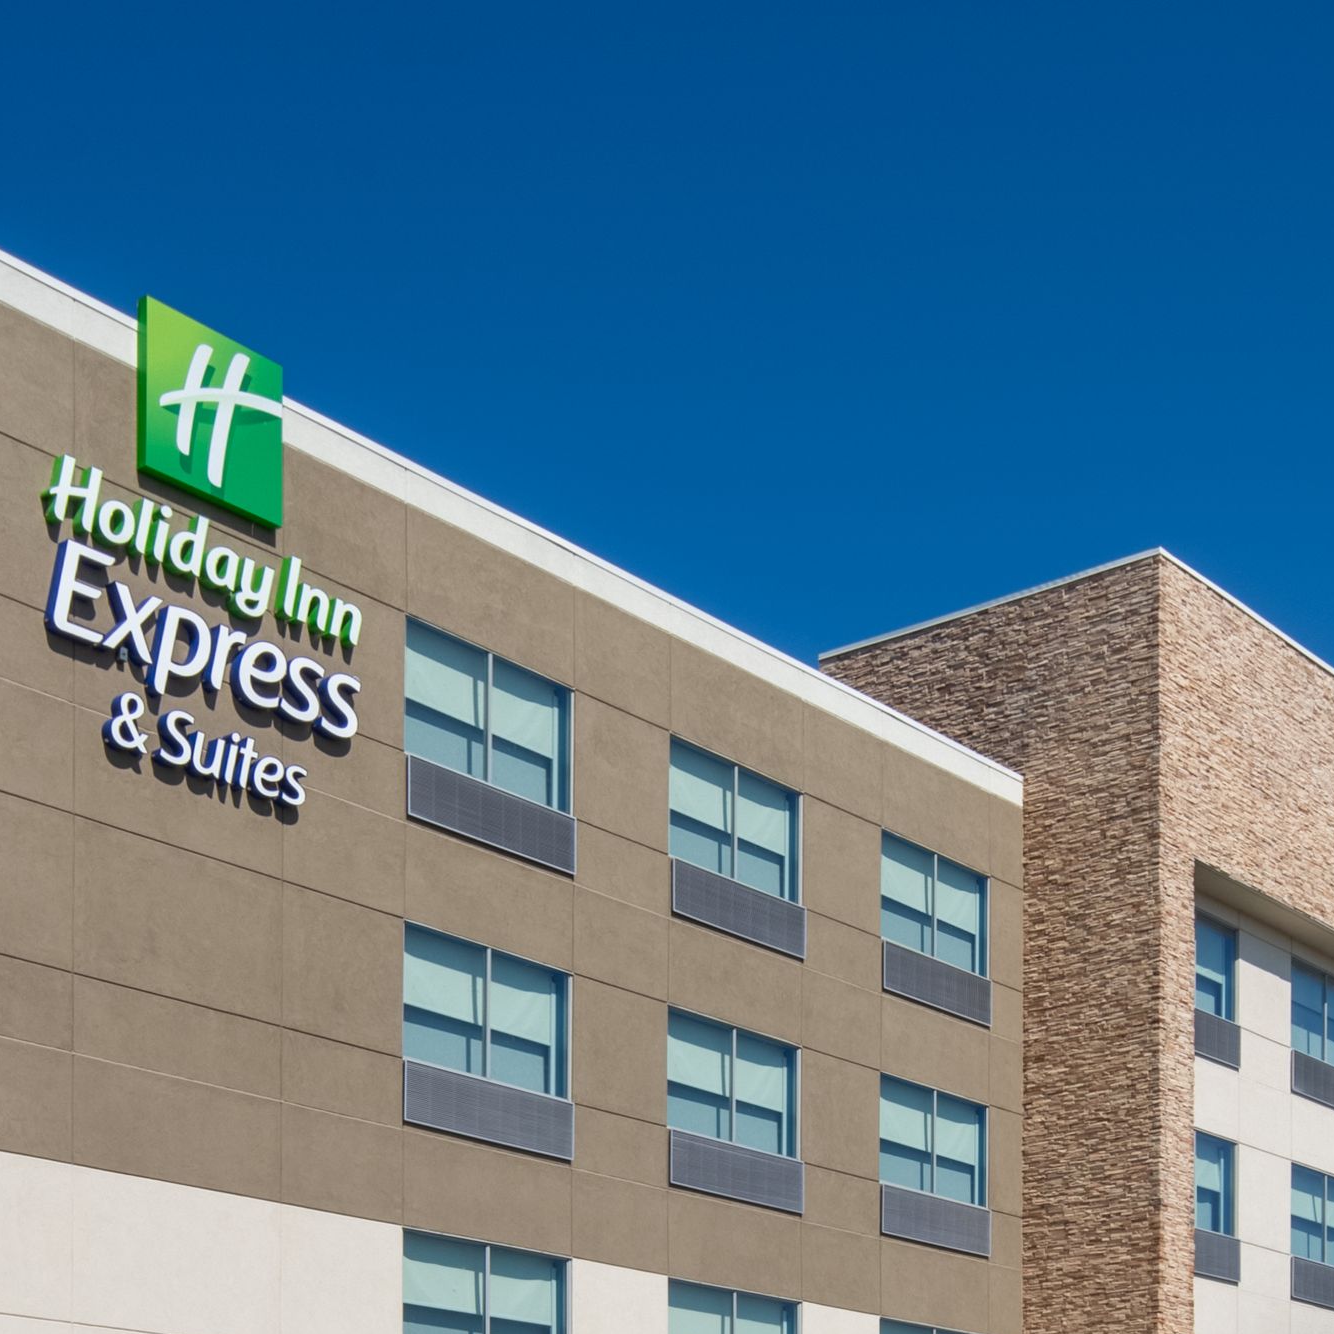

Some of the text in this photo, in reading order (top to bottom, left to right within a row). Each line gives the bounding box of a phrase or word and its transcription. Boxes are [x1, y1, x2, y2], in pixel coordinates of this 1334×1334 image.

[44, 454, 362, 647] Holiday Inn
[47, 539, 361, 738] Express
[105, 692, 308, 806] & Suites
